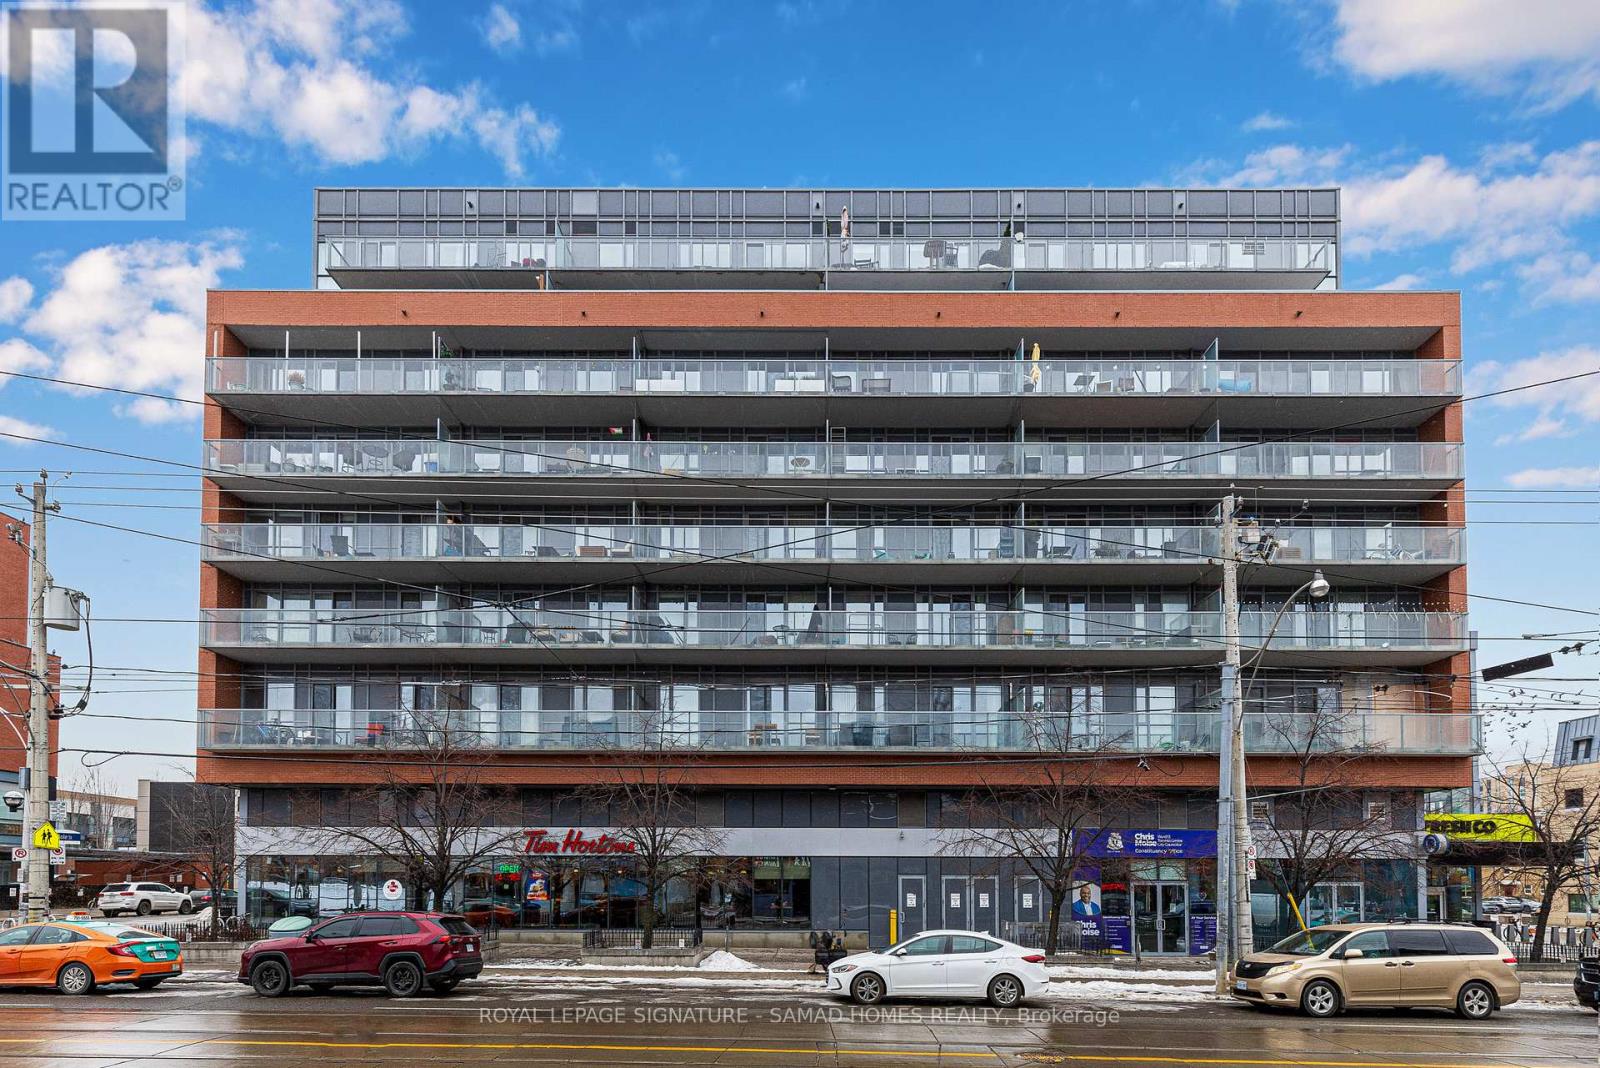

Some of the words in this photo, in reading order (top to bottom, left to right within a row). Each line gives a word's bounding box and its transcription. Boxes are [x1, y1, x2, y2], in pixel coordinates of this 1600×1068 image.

[1134, 832, 1155, 840] Chris
[524, 829, 559, 854] Tim
[1134, 839, 1157, 847] Moise
[500, 865, 520, 873] OPEN
